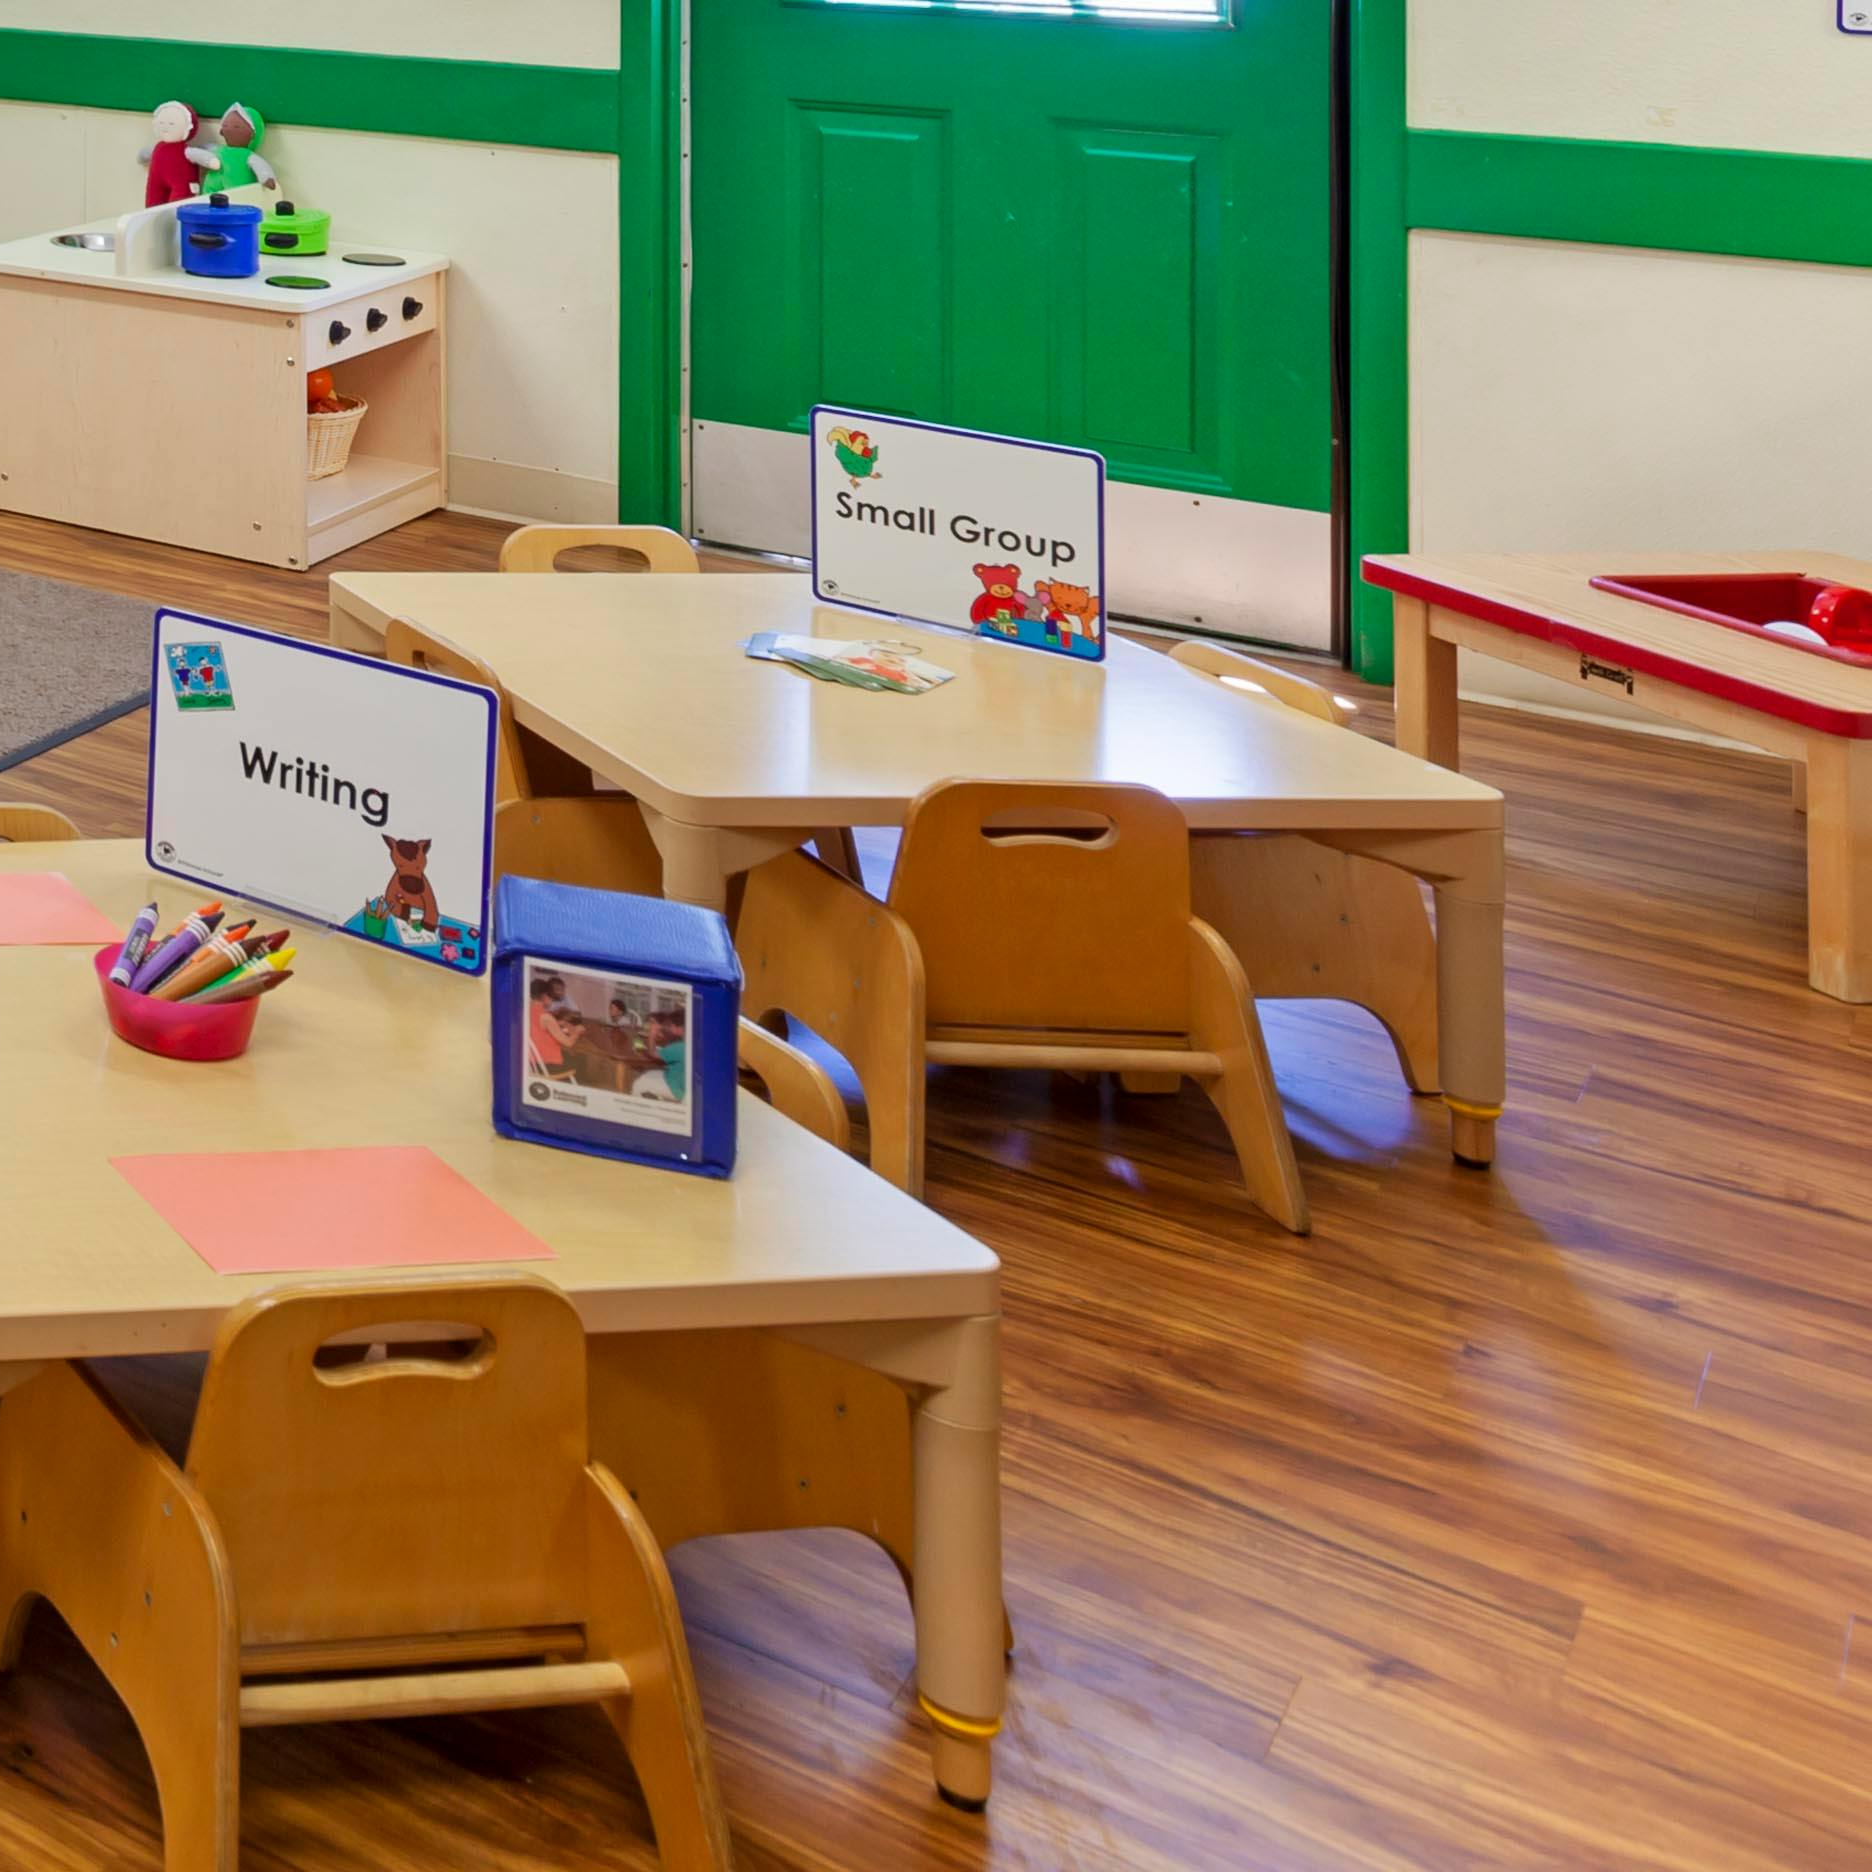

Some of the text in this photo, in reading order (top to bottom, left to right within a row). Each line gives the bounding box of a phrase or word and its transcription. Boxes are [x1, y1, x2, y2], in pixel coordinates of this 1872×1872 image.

[835, 491, 1077, 568] Small Group
[239, 741, 391, 828] Writing
